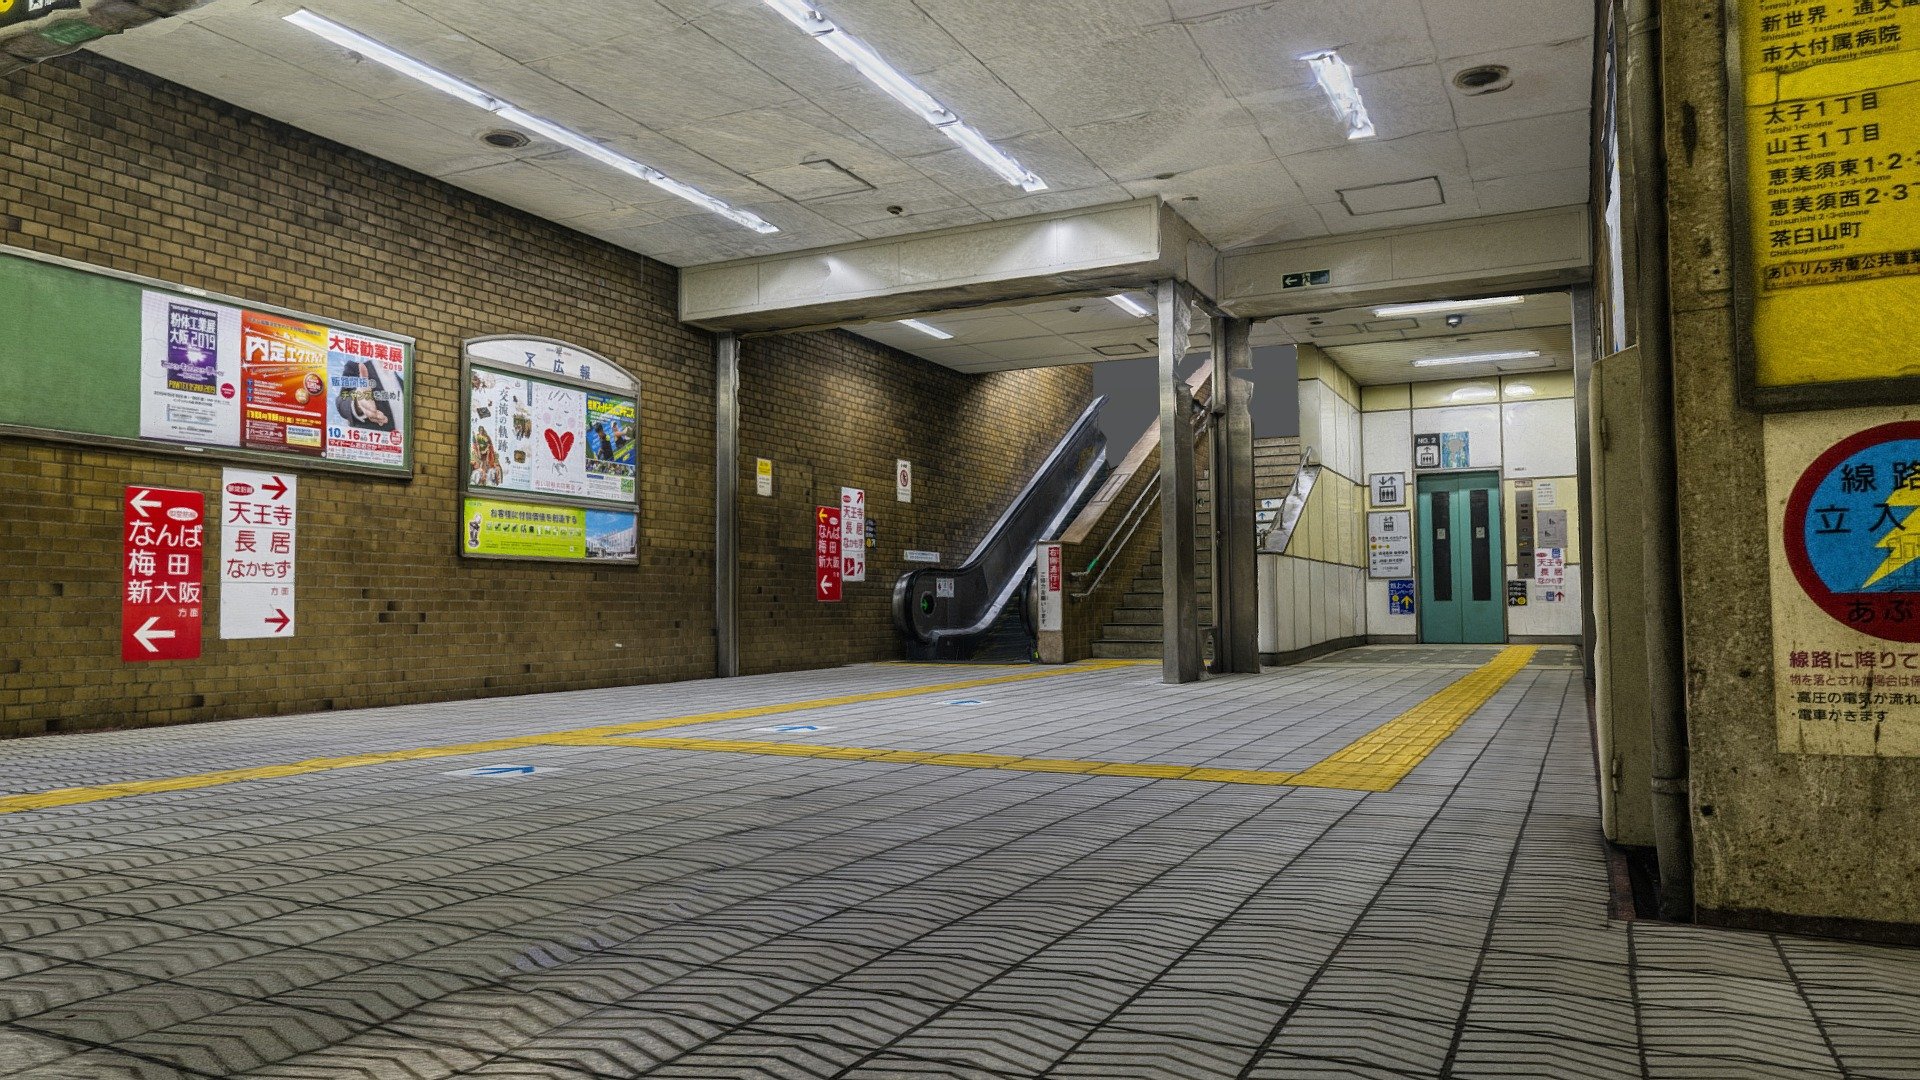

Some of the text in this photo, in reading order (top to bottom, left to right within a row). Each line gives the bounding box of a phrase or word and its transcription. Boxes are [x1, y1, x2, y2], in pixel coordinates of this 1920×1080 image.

[1762, 24, 1902, 63] 市大付属病院
[1764, 92, 1878, 125] 太子1丁目
[1767, 123, 1879, 156] 山王1丁目
[1770, 222, 1861, 248] 茶臼山町
[170, 328, 215, 350] 大阪 2019
[329, 335, 403, 363] 大阪勧業展
[383, 362, 403, 371] 2019
[497, 387, 510, 452] 交流の軌跡
[347, 429, 360, 441] 16
[368, 432, 381, 443] 17
[1841, 461, 1920, 494] 線路
[228, 501, 292, 526] 天王寺
[843, 506, 864, 519] 天王寺
[1814, 502, 1907, 536] 立入
[129, 520, 203, 547] なんば
[819, 524, 841, 539] なんば
[846, 522, 863, 535] 長居
[235, 530, 291, 554] 長居
[818, 540, 837, 554] 梅田
[843, 538, 864, 549] なかもず
[128, 549, 190, 576] 梅田
[227, 558, 292, 579] なかもず
[818, 555, 840, 569] 新大阪
[128, 579, 200, 604] 新大阪
[270, 587, 289, 596] 方面
[178, 608, 199, 617] 方面
[1847, 600, 1914, 625] あぶ
[1789, 650, 1919, 669] 線路に降りて
